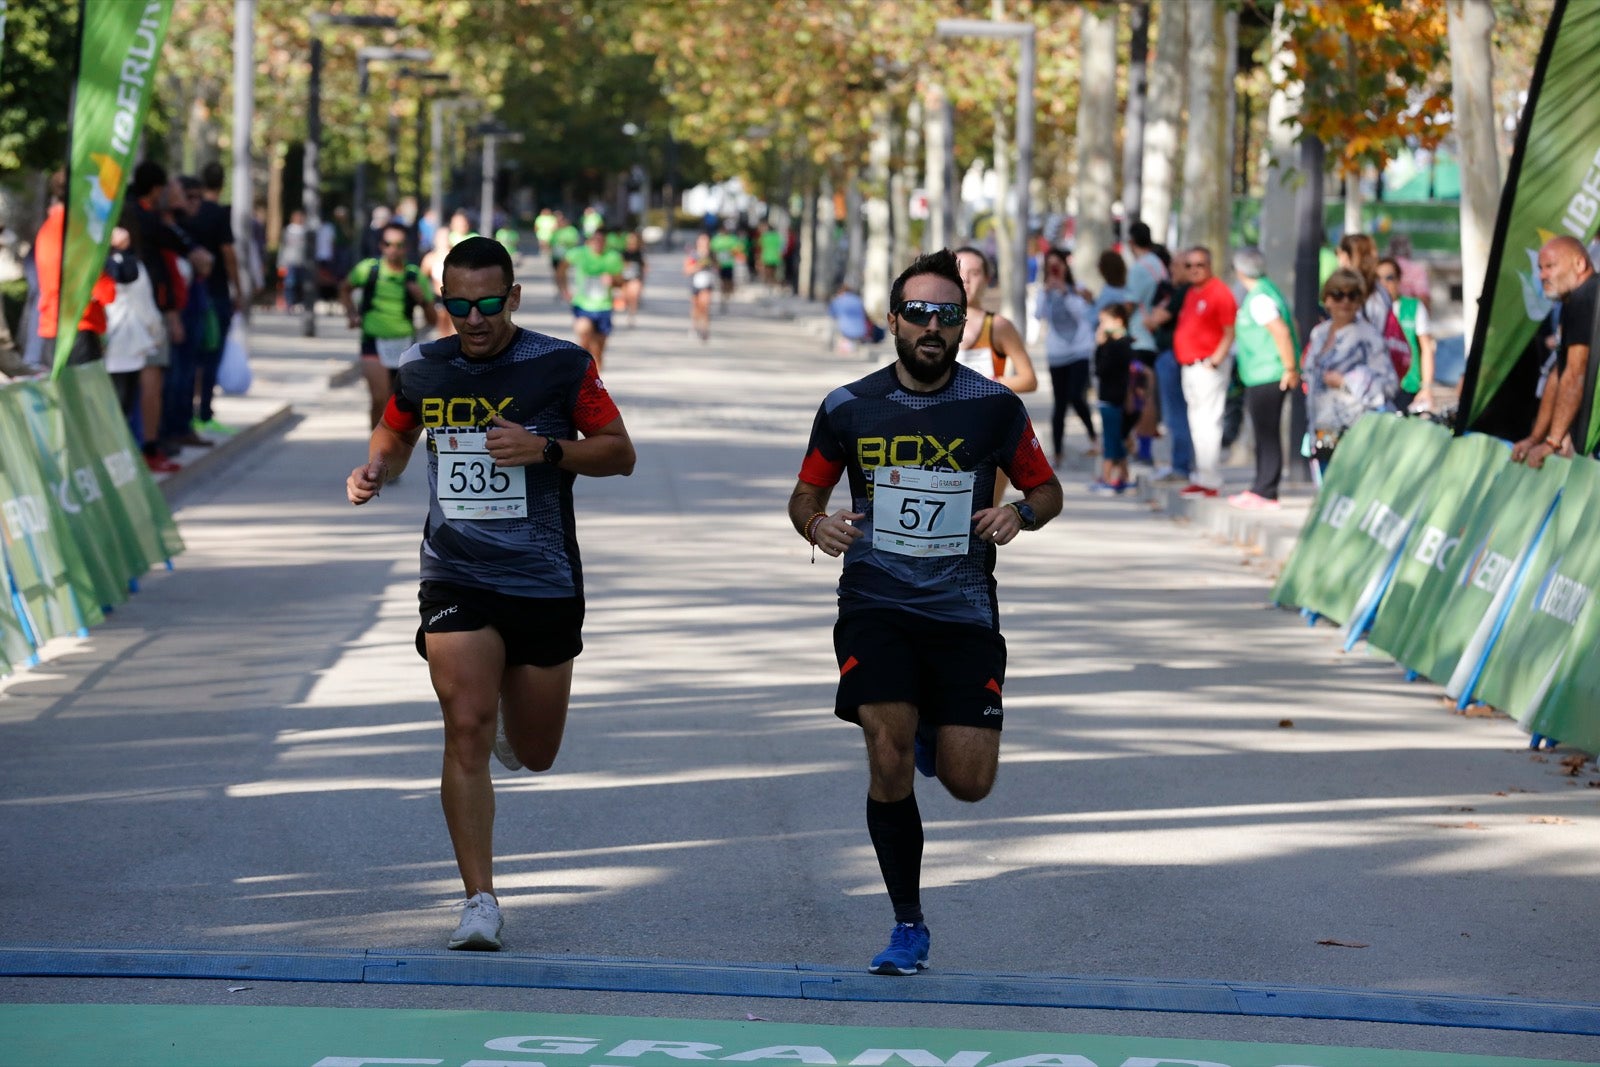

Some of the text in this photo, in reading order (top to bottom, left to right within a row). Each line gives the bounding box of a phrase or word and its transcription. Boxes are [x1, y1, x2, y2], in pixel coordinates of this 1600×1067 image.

[1561, 146, 1600, 238] IBE
[422, 397, 513, 427] BOX
[857, 435, 964, 471] BOX
[449, 462, 511, 493] 535
[899, 498, 946, 532] 57
[484, 1035, 1320, 1067] GRANAD
